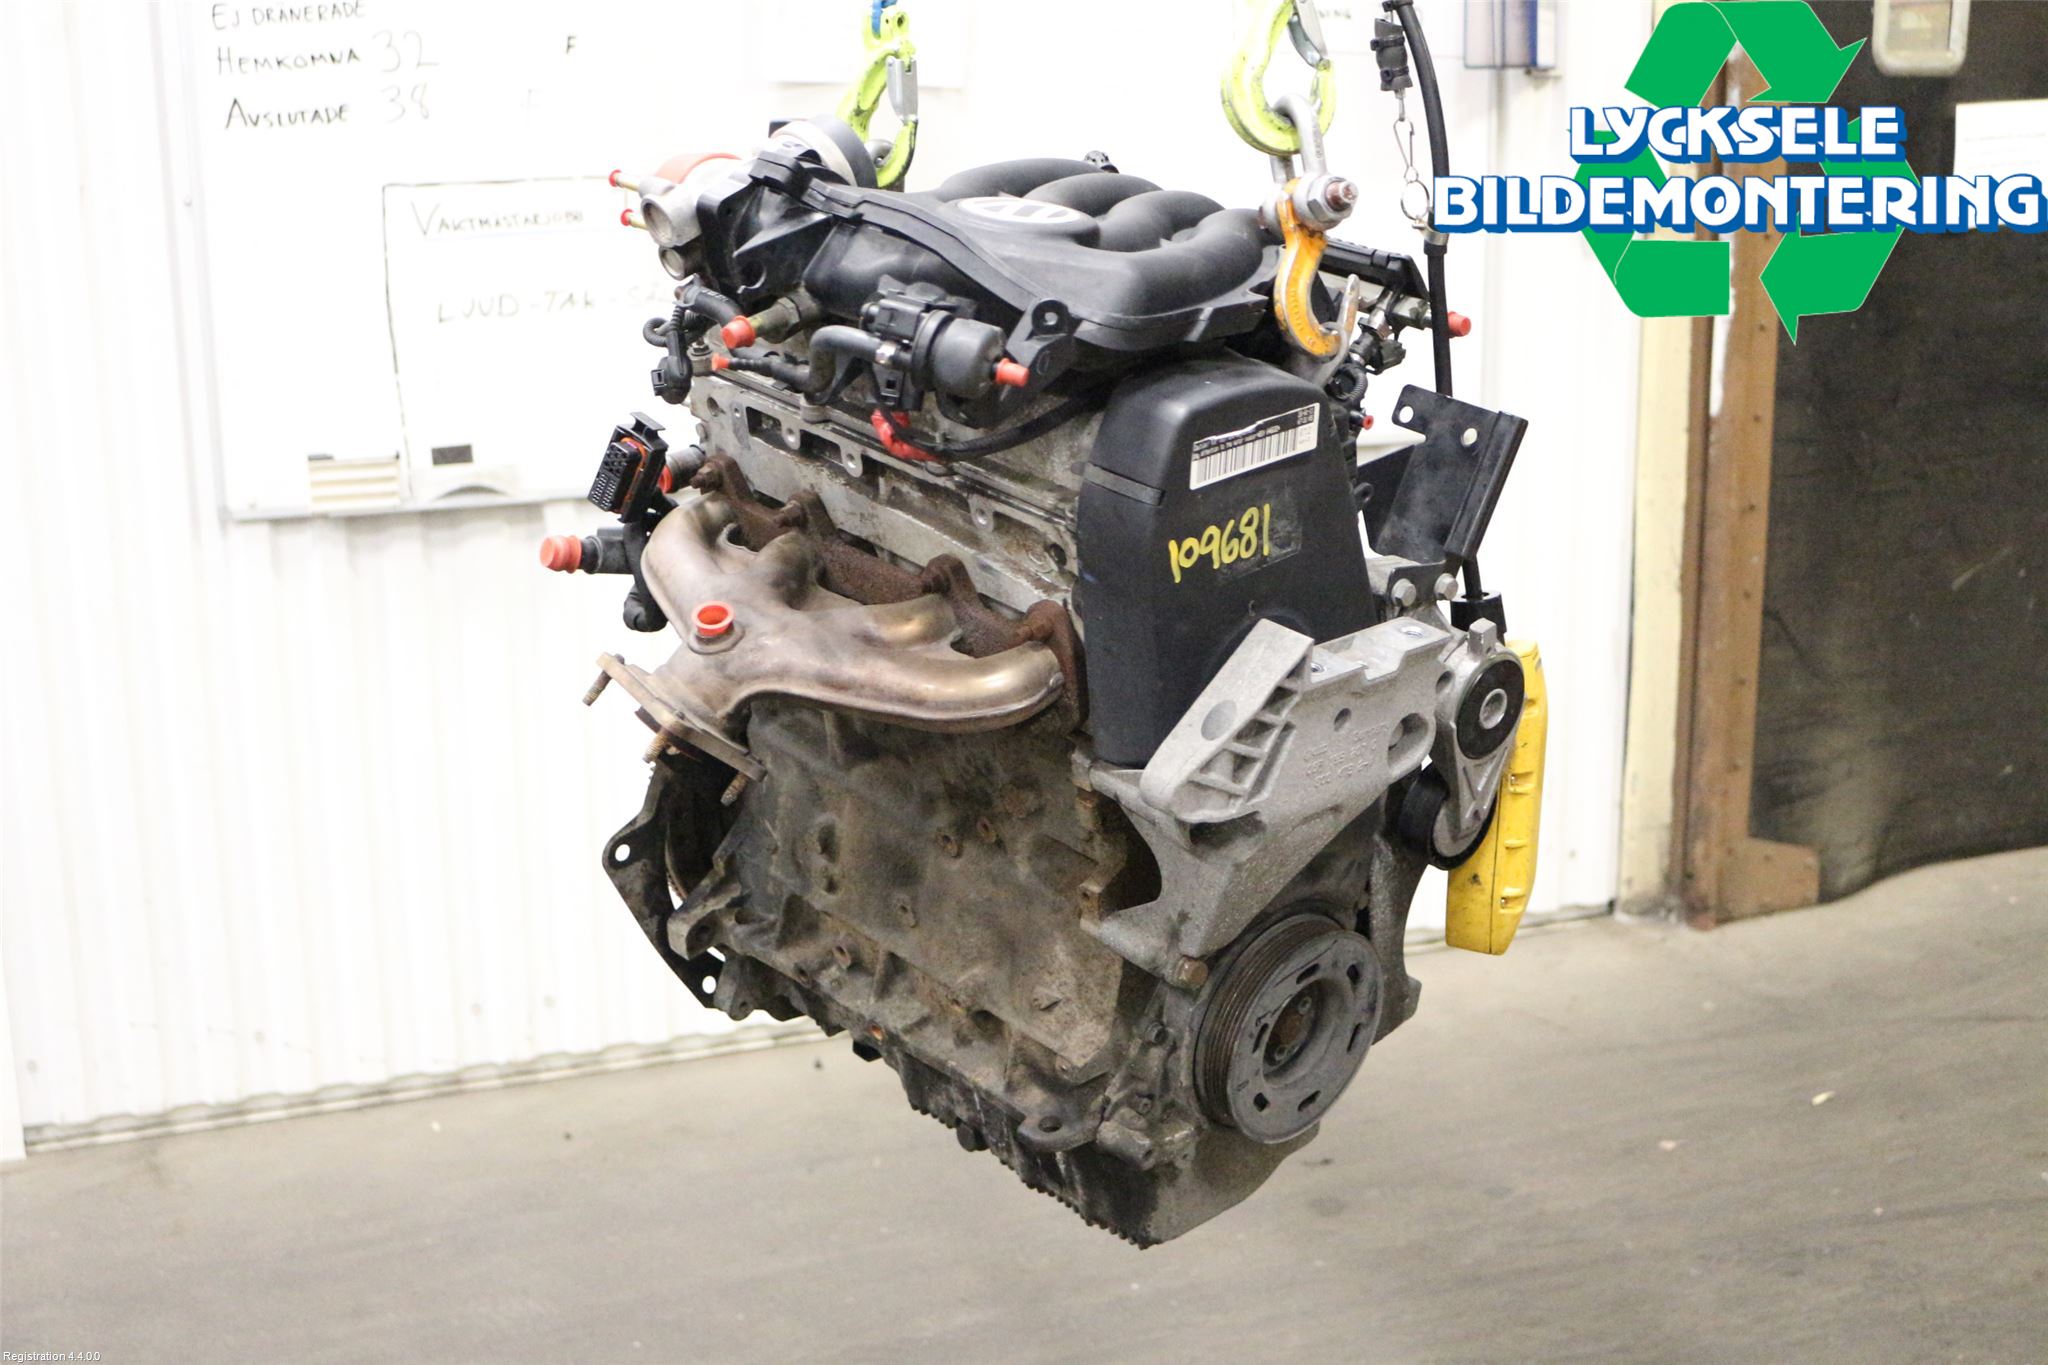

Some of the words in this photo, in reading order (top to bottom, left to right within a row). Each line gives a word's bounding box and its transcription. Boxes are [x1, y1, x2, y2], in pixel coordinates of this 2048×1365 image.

[371, 29, 440, 74] 32
[380, 82, 430, 124] 38
[1167, 502, 1271, 584] 109681
